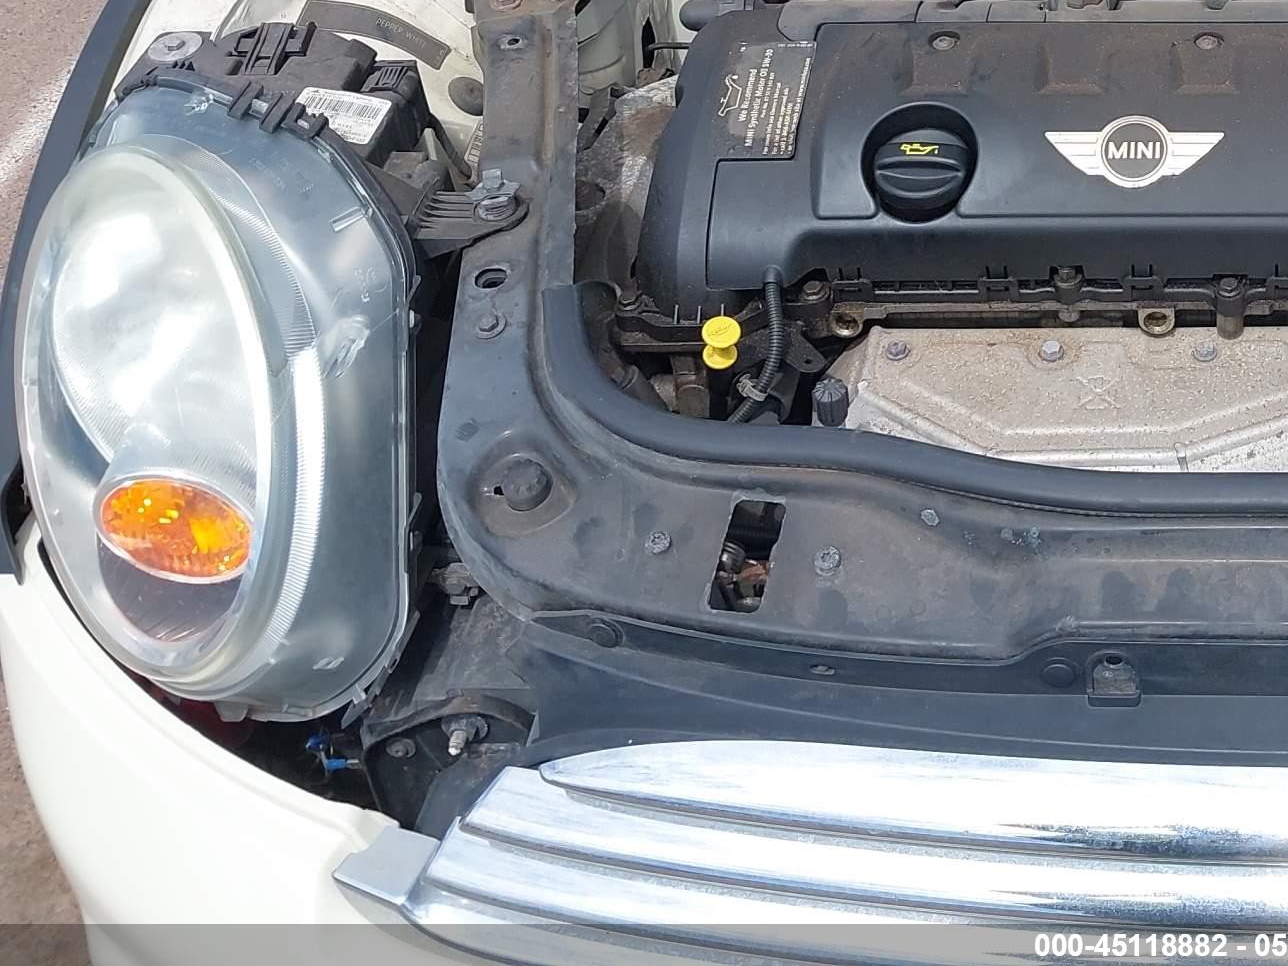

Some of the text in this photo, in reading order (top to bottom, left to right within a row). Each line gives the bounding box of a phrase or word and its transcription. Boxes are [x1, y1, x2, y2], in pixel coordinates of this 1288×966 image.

[760, 68, 768, 76] Oil
[738, 69, 757, 121] We Recommend
[756, 78, 765, 96] Motor
[748, 99, 761, 127] Synthetic
[744, 128, 754, 146] MINI
[1107, 141, 1161, 159] MINI
